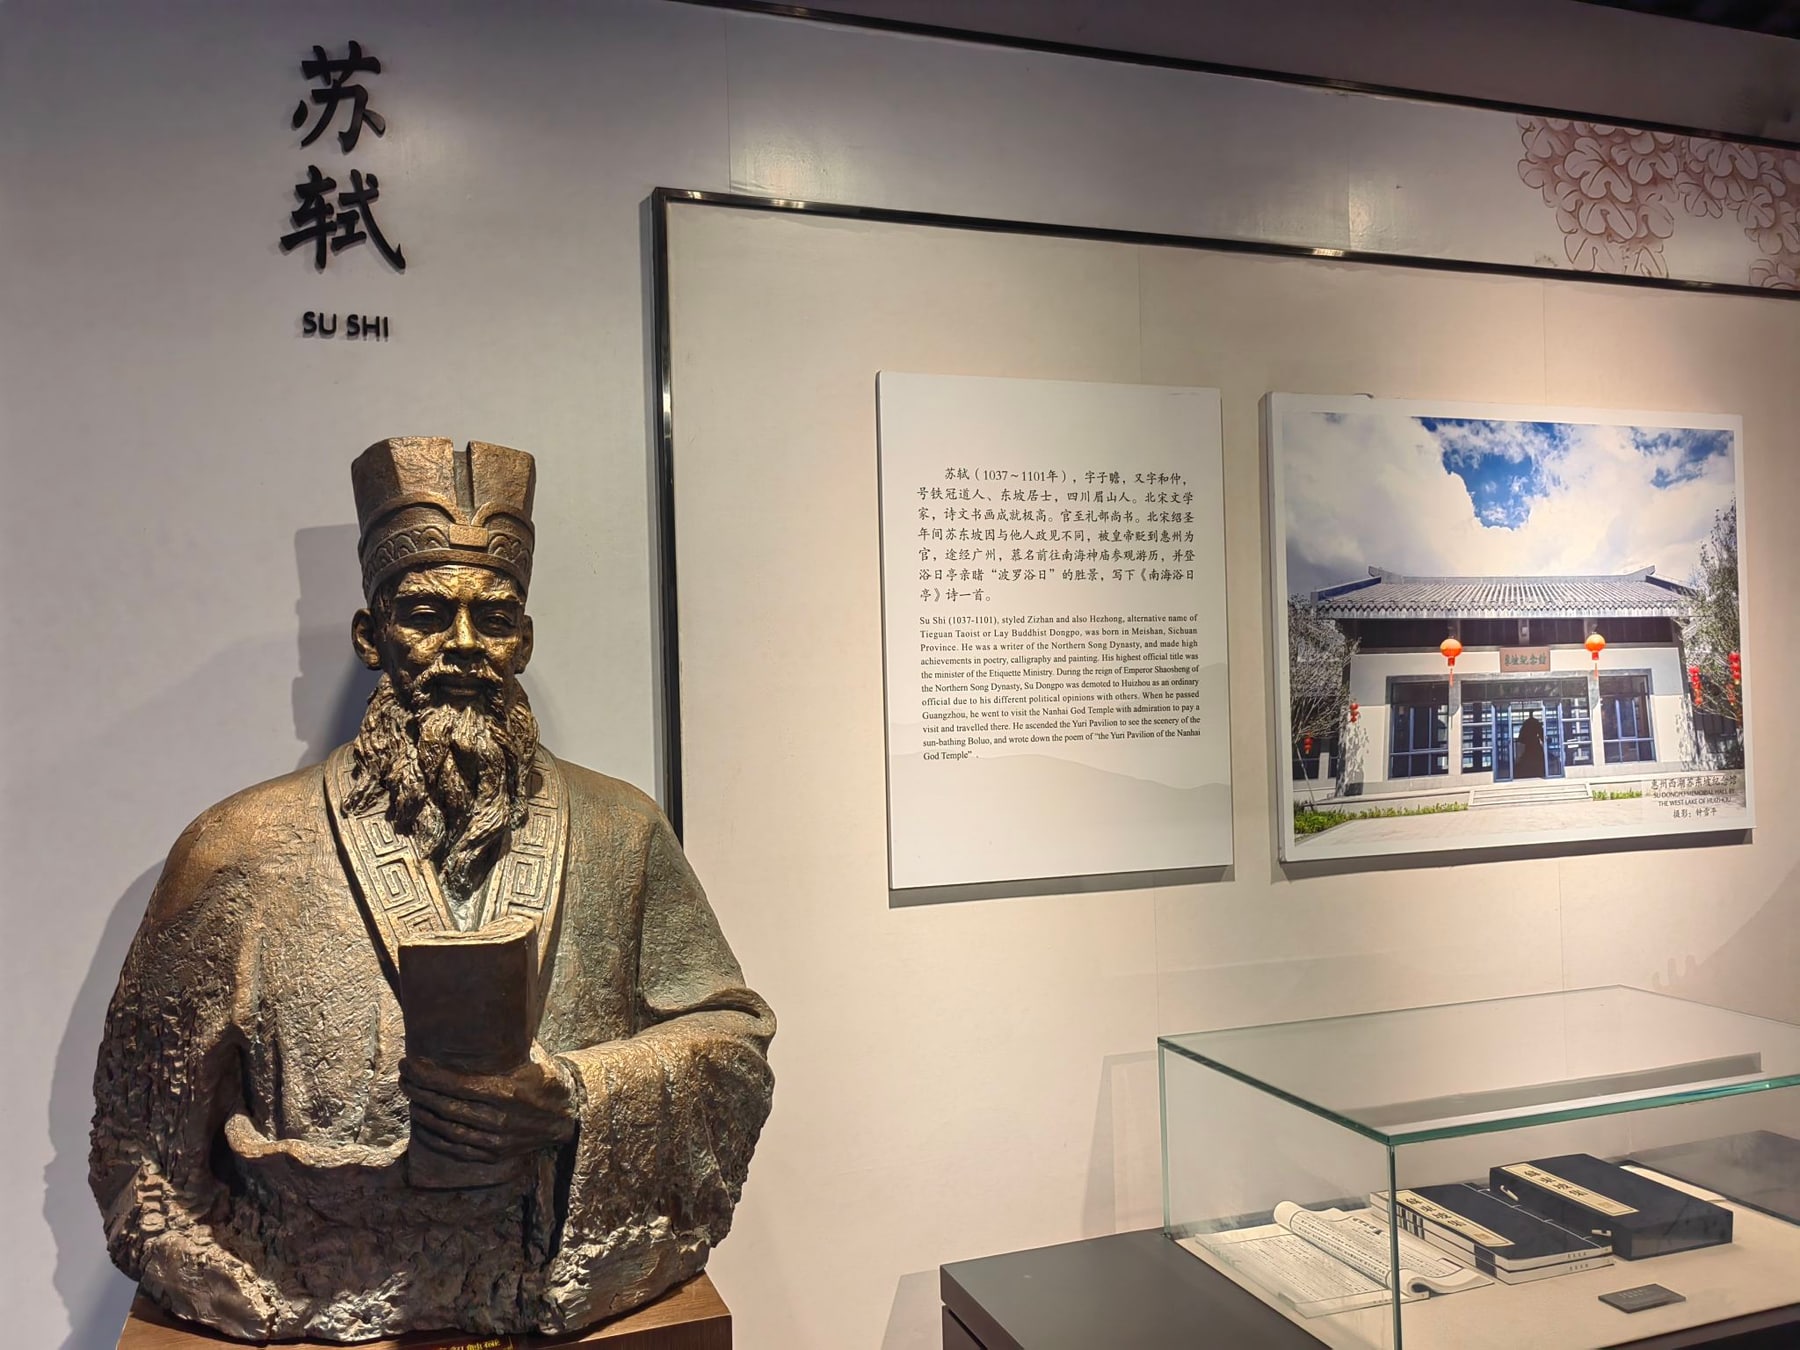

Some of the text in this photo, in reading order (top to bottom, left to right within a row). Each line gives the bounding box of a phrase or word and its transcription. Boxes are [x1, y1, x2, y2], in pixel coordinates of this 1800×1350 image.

[281, 39, 407, 273] 苏轼
[303, 311, 389, 338] SU SHI
[919, 617, 930, 625] Su
[932, 617, 946, 625] Shi
[1001, 616, 1026, 625] styled
[1071, 615, 1088, 623] also
[1126, 615, 1167, 623] alternative
[1189, 614, 1198, 622] of
[921, 630, 953, 640] Tieguan
[954, 630, 980, 638] Taoist
[994, 630, 1011, 639] Lay
[1012, 629, 1048, 637] Buddhist
[1049, 629, 1083, 638] Dongpo,
[1102, 628, 1120, 636] born
[1121, 628, 1130, 636] in
[1131, 628, 1166, 638] Meishan,
[1167, 628, 1198, 636] Sichuan
[920, 643, 959, 651] Province.
[961, 643, 973, 651] He
[1000, 642, 1025, 650] writer
[1026, 642, 1036, 650] of
[1037, 642, 1049, 650] the
[1050, 642, 1086, 650] Northern
[1087, 641, 1108, 651] Song
[1109, 641, 1143, 650] Dynasty,
[1159, 640, 1180, 648] made
[1181, 640, 1198, 649] high
[920, 657, 972, 665] achievements
[973, 656, 982, 664] in
[982, 656, 1009, 665] poetry,
[1010, 655, 1052, 665] calligraphy
[1053, 655, 1067, 663] and
[1068, 654, 1101, 664] painting.
[1102, 654, 1114, 662] His
[1116, 653, 1142, 663] highest
[1143, 653, 1168, 661] official
[1169, 653, 1184, 661] title
[934, 670, 965, 678] minister
[966, 670, 975, 678] of
[976, 669, 988, 677] the
[988, 669, 1021, 679] Etiquette
[1022, 668, 1056, 678] Ministry.
[1057, 668, 1081, 677] During
[1082, 667, 1094, 675] the
[1095, 667, 1113, 676] reign
[1124, 666, 1153, 676] Emperor
[1192, 665, 1199, 673] of
[921, 684, 934, 692] the
[935, 683, 969, 692] Northern
[969, 683, 990, 692] Song
[990, 682, 1023, 692] Dynasty,
[1024, 682, 1034, 690] Su
[1035, 681, 1064, 691] Dongpo
[1081, 680, 1111, 688] demoted
[1112, 680, 1120, 688] to
[1121, 679, 1151, 687] Huizhou
[1171, 678, 1199, 688] ordinary
[921, 691, 1200, 705] official due to his different political opinions with others. When he passed
[922, 710, 969, 721] Guangzhou,
[969, 710, 980, 718] he
[981, 709, 1000, 717] went
[1001, 709, 1009, 717] to
[1010, 709, 1028, 717] visit
[1029, 708, 1041, 716] the
[1042, 707, 1069, 716] Nanhai
[1070, 707, 1086, 715] God
[1087, 706, 1114, 716] Temple
[1115, 706, 1132, 714] with
[1133, 704, 1172, 713] admiration
[1172, 704, 1180, 712] to
[1181, 705, 1195, 713] pay
[922, 725, 939, 733] visit
[940, 724, 955, 732] and
[956, 723, 989, 732] travelled
[990, 722, 1011, 731] there.
[1012, 722, 1024, 730] He
[1025, 721, 1058, 729] ascended
[1059, 720, 1071, 728] the
[1072, 720, 1088, 728] Yuri
[1089, 719, 1118, 727] Pavilion
[1141, 718, 1152, 726] the
[1153, 718, 1180, 726] scenery
[1181, 716, 1188, 724] of
[1189, 716, 1201, 724] the
[922, 737, 966, 748] sun-bathing
[967, 736, 993, 746] Boluo,
[993, 736, 1008, 744] and
[1008, 735, 1029, 743] wrote
[1030, 734, 1050, 742] down
[1052, 734, 1063, 742] the
[1064, 734, 1084, 743] poem
[1085, 732, 1093, 740] of
[1110, 731, 1126, 739] Yuri
[1126, 730, 1155, 739] Pavilion
[1156, 730, 1164, 738] of
[1165, 729, 1176, 737] the
[1177, 729, 1201, 737] Nanhai
[923, 752, 940, 760] God
